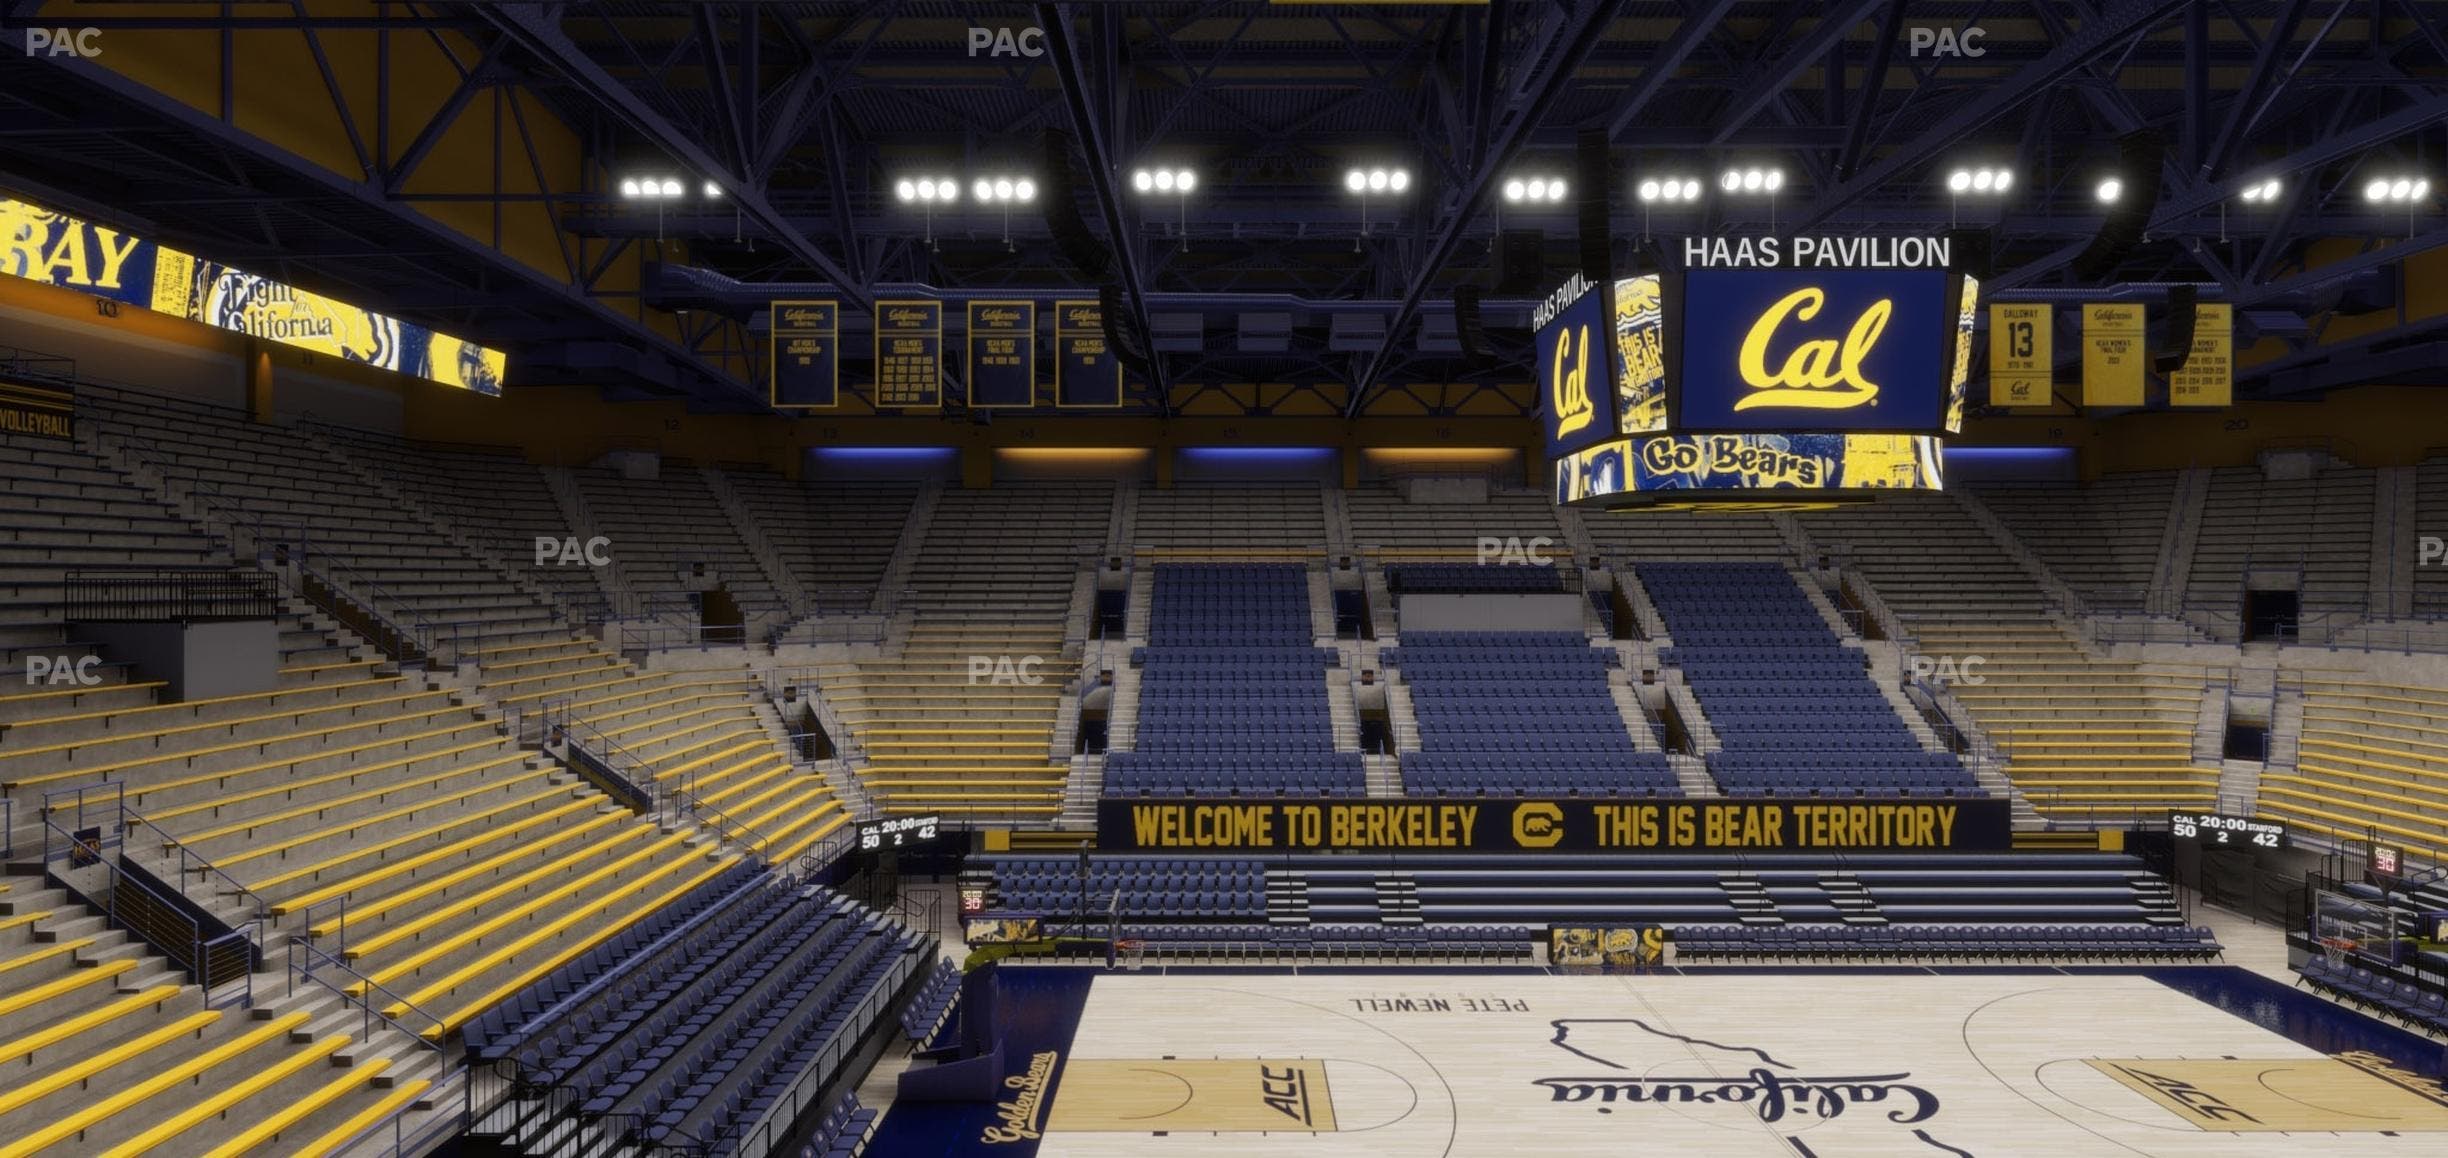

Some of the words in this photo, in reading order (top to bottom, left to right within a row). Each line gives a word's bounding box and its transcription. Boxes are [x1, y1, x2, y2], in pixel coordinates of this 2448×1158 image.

[1685, 237, 1780, 267] HAAS
[1793, 237, 1950, 267] PAVILION
[96, 298, 118, 317] 10
[1533, 293, 1555, 334] HAAS
[1557, 269, 1599, 315] PAVILI
[1734, 287, 1892, 411] Cal
[2009, 322, 2034, 358] 13
[1623, 343, 1662, 377] BEAR
[1554, 323, 1593, 440] Cal
[0, 407, 71, 437] VOLLEYBALL
[1646, 437, 1698, 471] Go
[1712, 437, 1818, 485] Bears
[861, 826, 880, 835] CAL
[882, 817, 915, 834] 20:00
[862, 834, 880, 850] 50
[894, 833, 903, 846] 2
[918, 825, 937, 839] 42
[1133, 805, 1273, 847] WELCOME
[1283, 805, 1321, 847] TO
[1330, 805, 1477, 847] BERKELEY
[1594, 805, 1659, 847] THIS
[1668, 805, 1696, 847] IS
[1705, 805, 1782, 847] BEAR
[1793, 805, 1957, 847] TERRITORY
[2173, 815, 2198, 826] CAL
[2200, 815, 2247, 831] 20:00
[2174, 825, 2198, 838] 50
[2217, 831, 2229, 843] 2
[2253, 832, 2279, 848] 42
[1348, 998, 1452, 1013] NEWELL
[1461, 998, 1530, 1012] PETE
[1260, 1064, 1302, 1121] ACC
[1531, 1068, 1940, 1124] California
